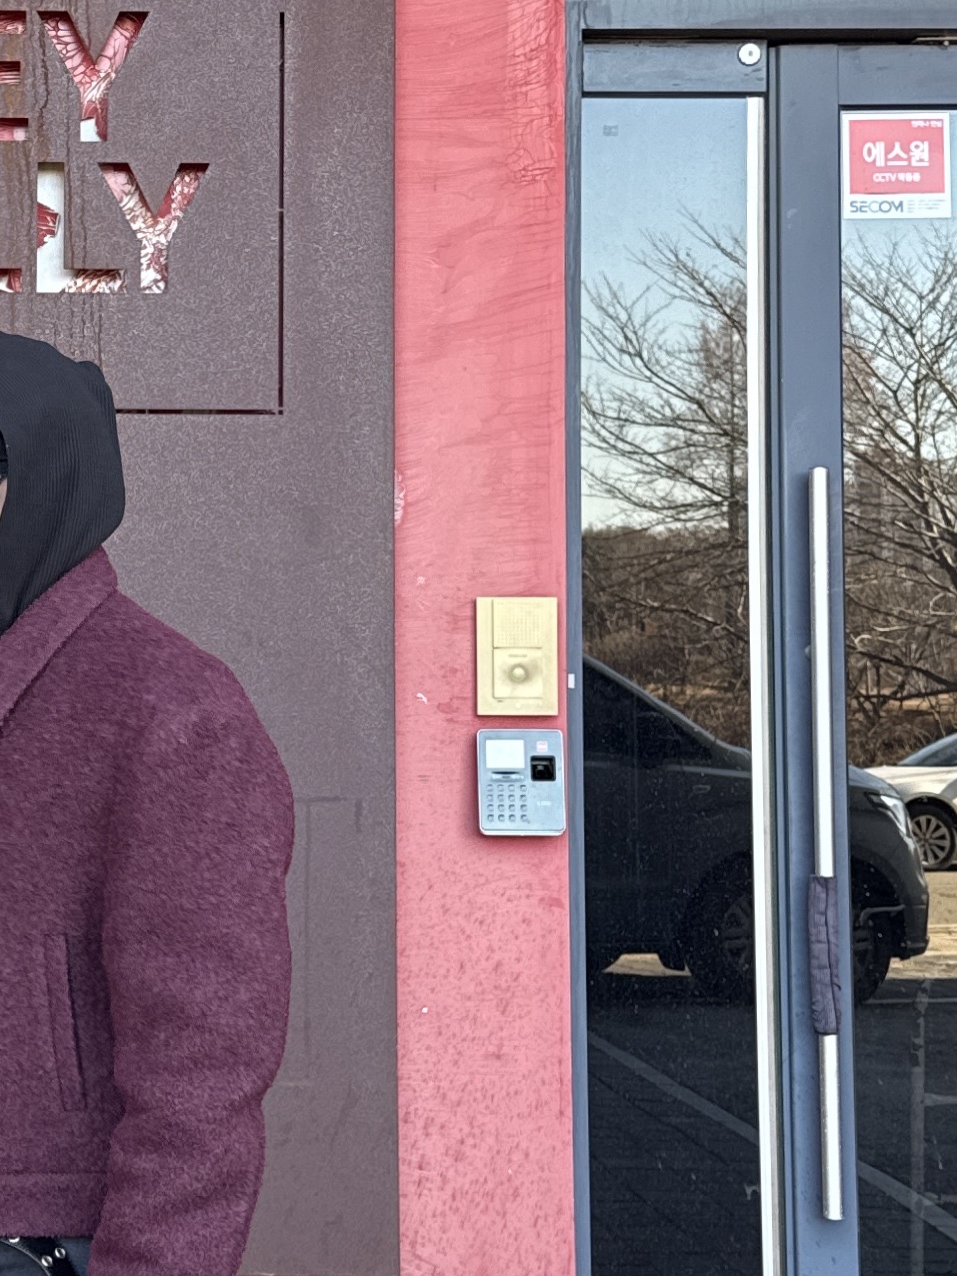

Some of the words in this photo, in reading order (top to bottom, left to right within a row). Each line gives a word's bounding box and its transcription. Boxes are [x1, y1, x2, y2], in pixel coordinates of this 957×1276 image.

[862, 140, 930, 167] 에스원
[873, 172, 896, 183] CCTV
[849, 200, 904, 214] SECOM
